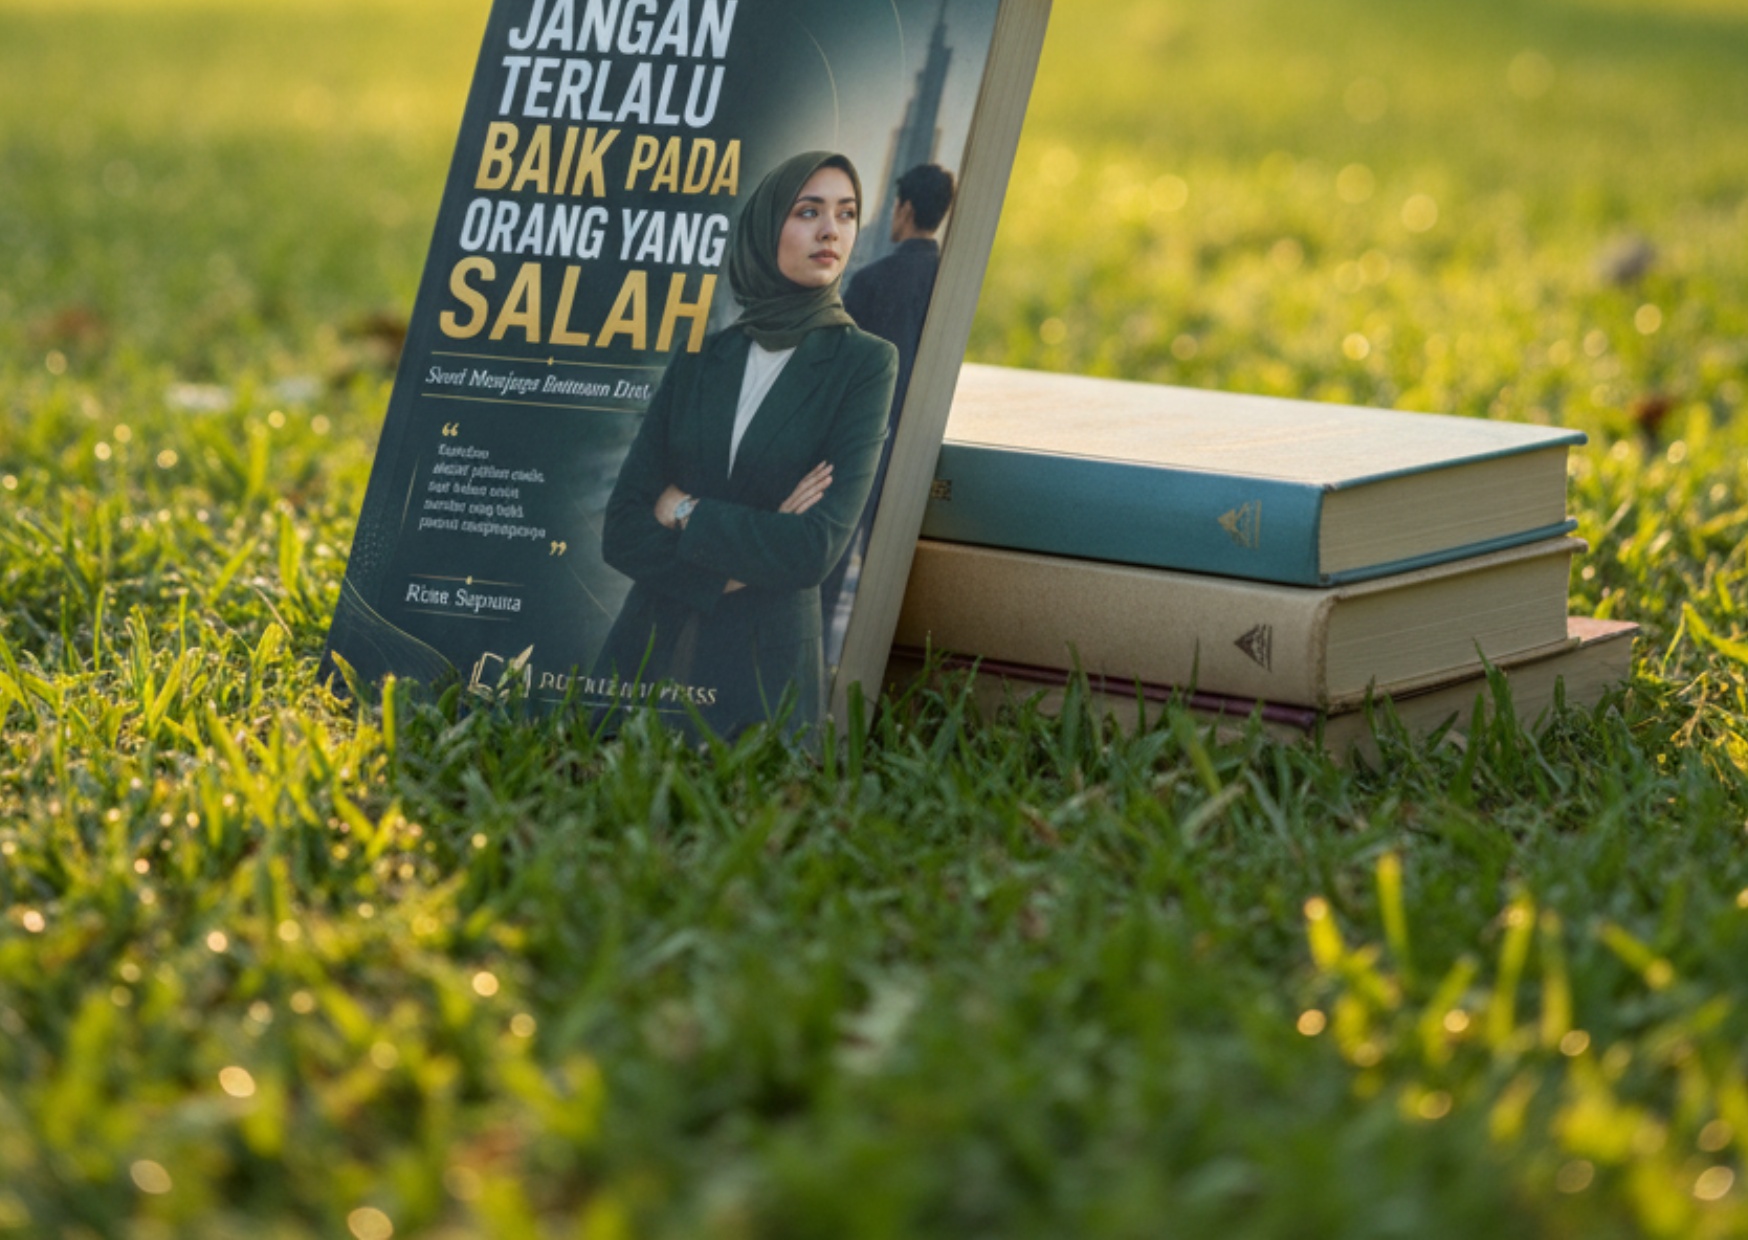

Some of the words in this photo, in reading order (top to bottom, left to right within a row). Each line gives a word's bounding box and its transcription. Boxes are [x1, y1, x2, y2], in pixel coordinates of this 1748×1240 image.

[499, 56, 725, 127] TERLALU
[476, 122, 620, 196] BAIK
[626, 136, 740, 195] PADA
[460, 198, 608, 259] ORANG
[620, 209, 730, 267] YANG
[440, 257, 717, 352] SALAH
